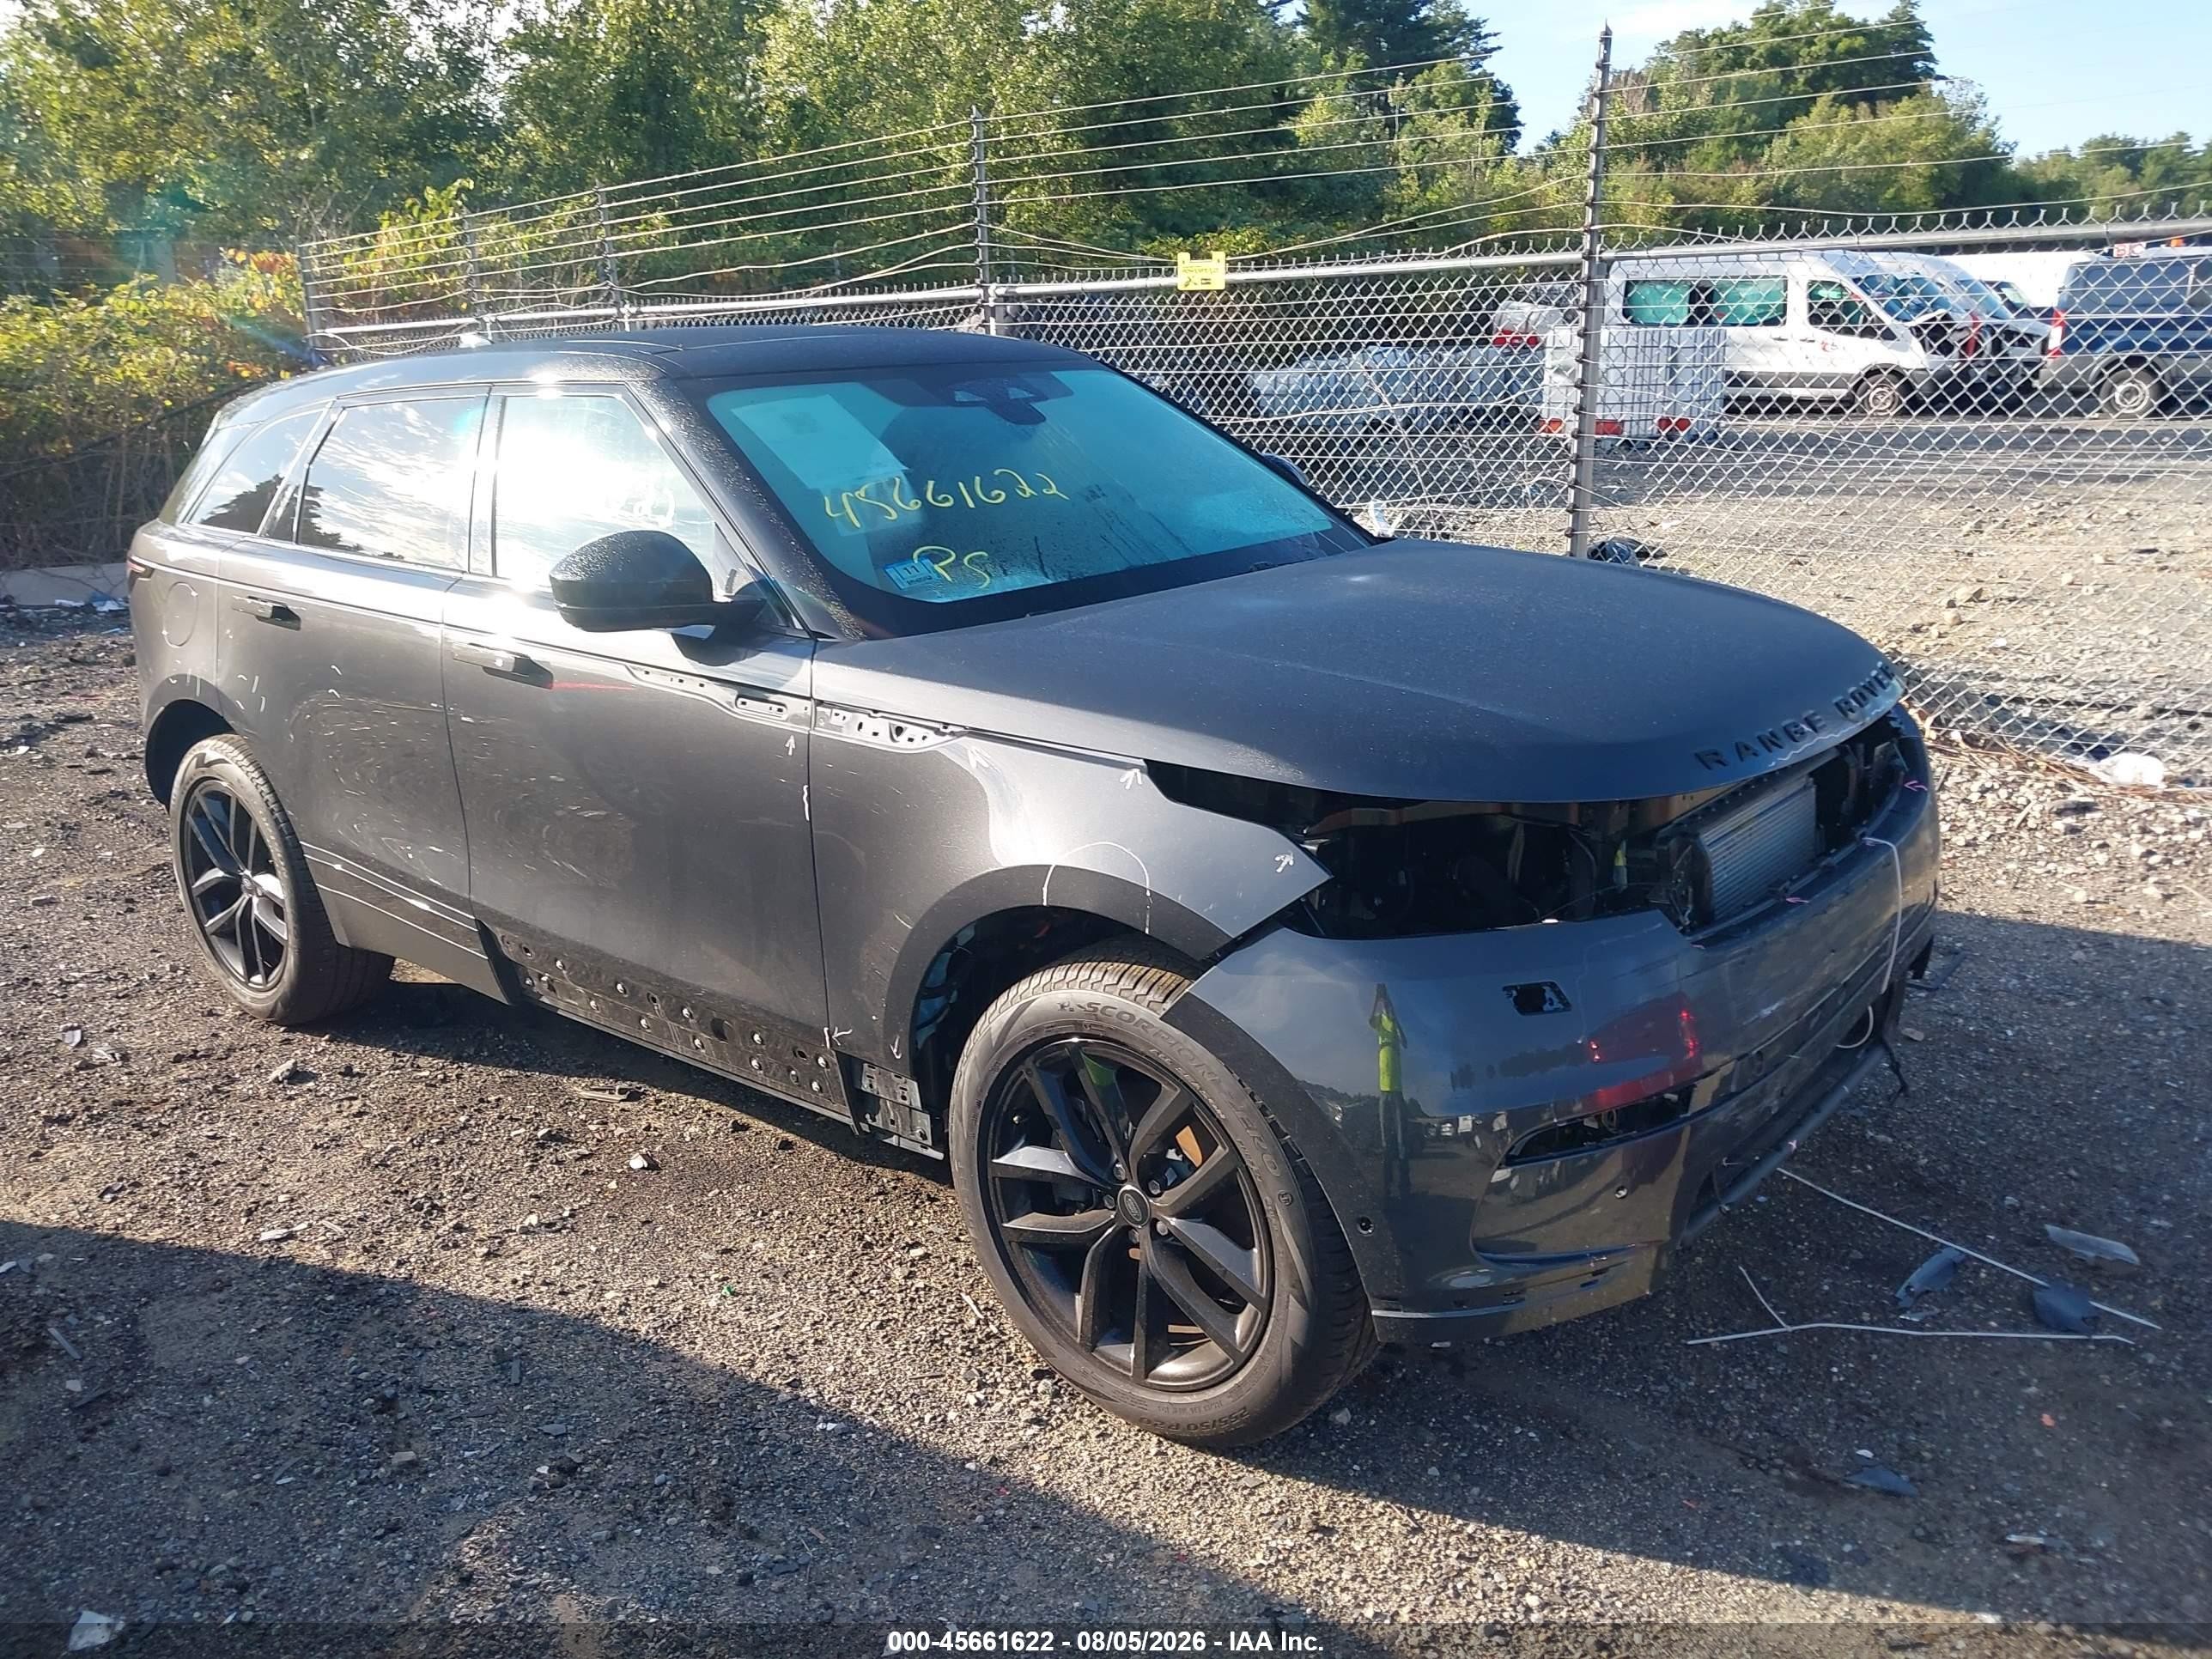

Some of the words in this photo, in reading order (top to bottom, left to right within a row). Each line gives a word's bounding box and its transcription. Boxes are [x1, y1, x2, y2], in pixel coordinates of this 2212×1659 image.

[824, 468, 1070, 529] 45661622
[1693, 709, 1827, 770] RANGE
[1832, 660, 1895, 720] ROVER
[1083, 1001, 1222, 1084] SCORPION
